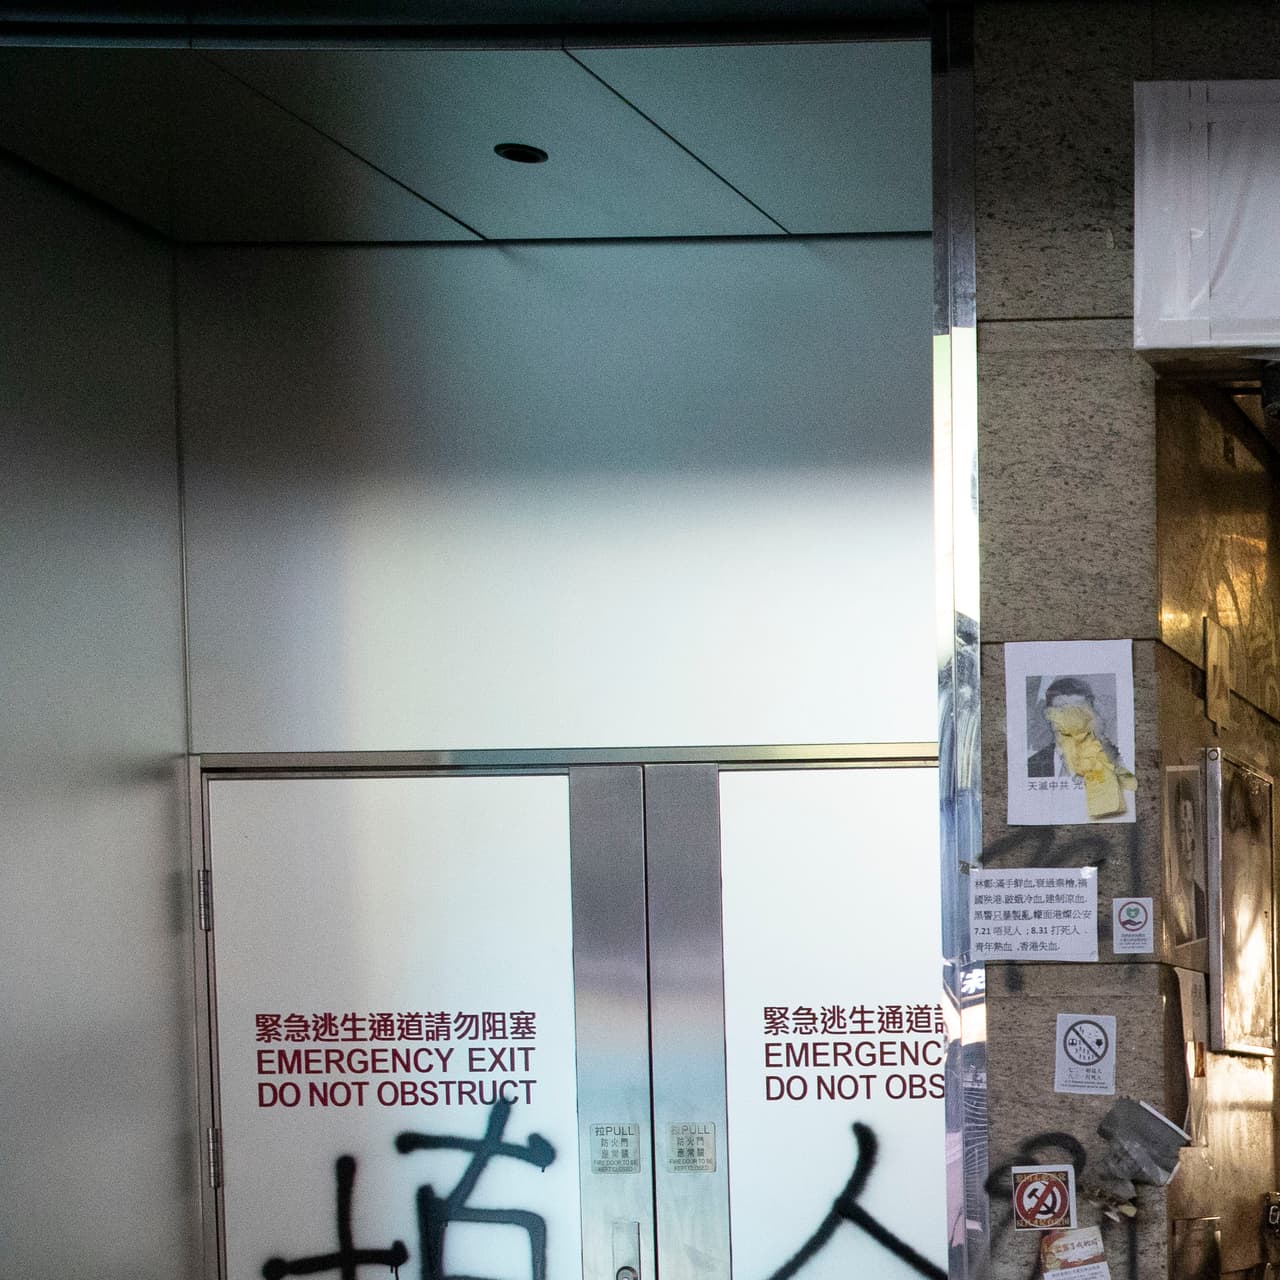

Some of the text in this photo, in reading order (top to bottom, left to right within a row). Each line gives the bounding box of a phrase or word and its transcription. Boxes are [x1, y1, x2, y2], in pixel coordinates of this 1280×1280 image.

[255, 1011, 537, 1043] 緊急逃生通道請勿阻塞
[257, 1046, 535, 1075] EMERGENCY EXIT
[258, 1079, 538, 1108] DO NOT OBSTRUCT
[765, 1075, 808, 1102] DO
[816, 1074, 877, 1101] NOT
